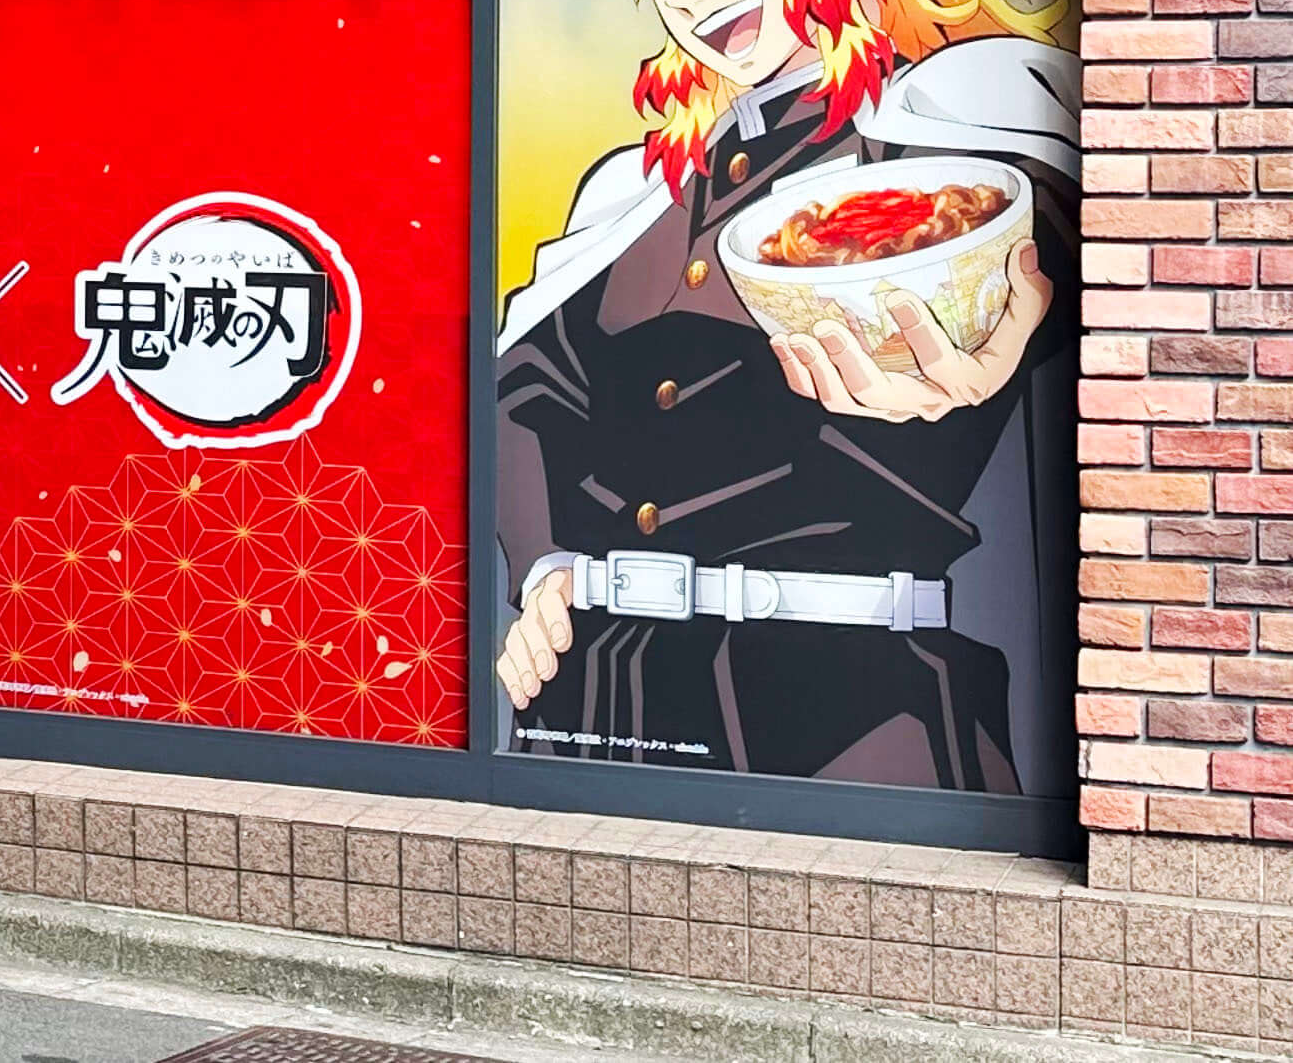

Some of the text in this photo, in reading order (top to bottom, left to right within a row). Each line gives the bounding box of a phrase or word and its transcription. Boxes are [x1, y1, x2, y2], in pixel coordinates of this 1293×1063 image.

[150, 249, 294, 269] きめつのやいば
[60, 271, 328, 395] 鬼滅の刃
